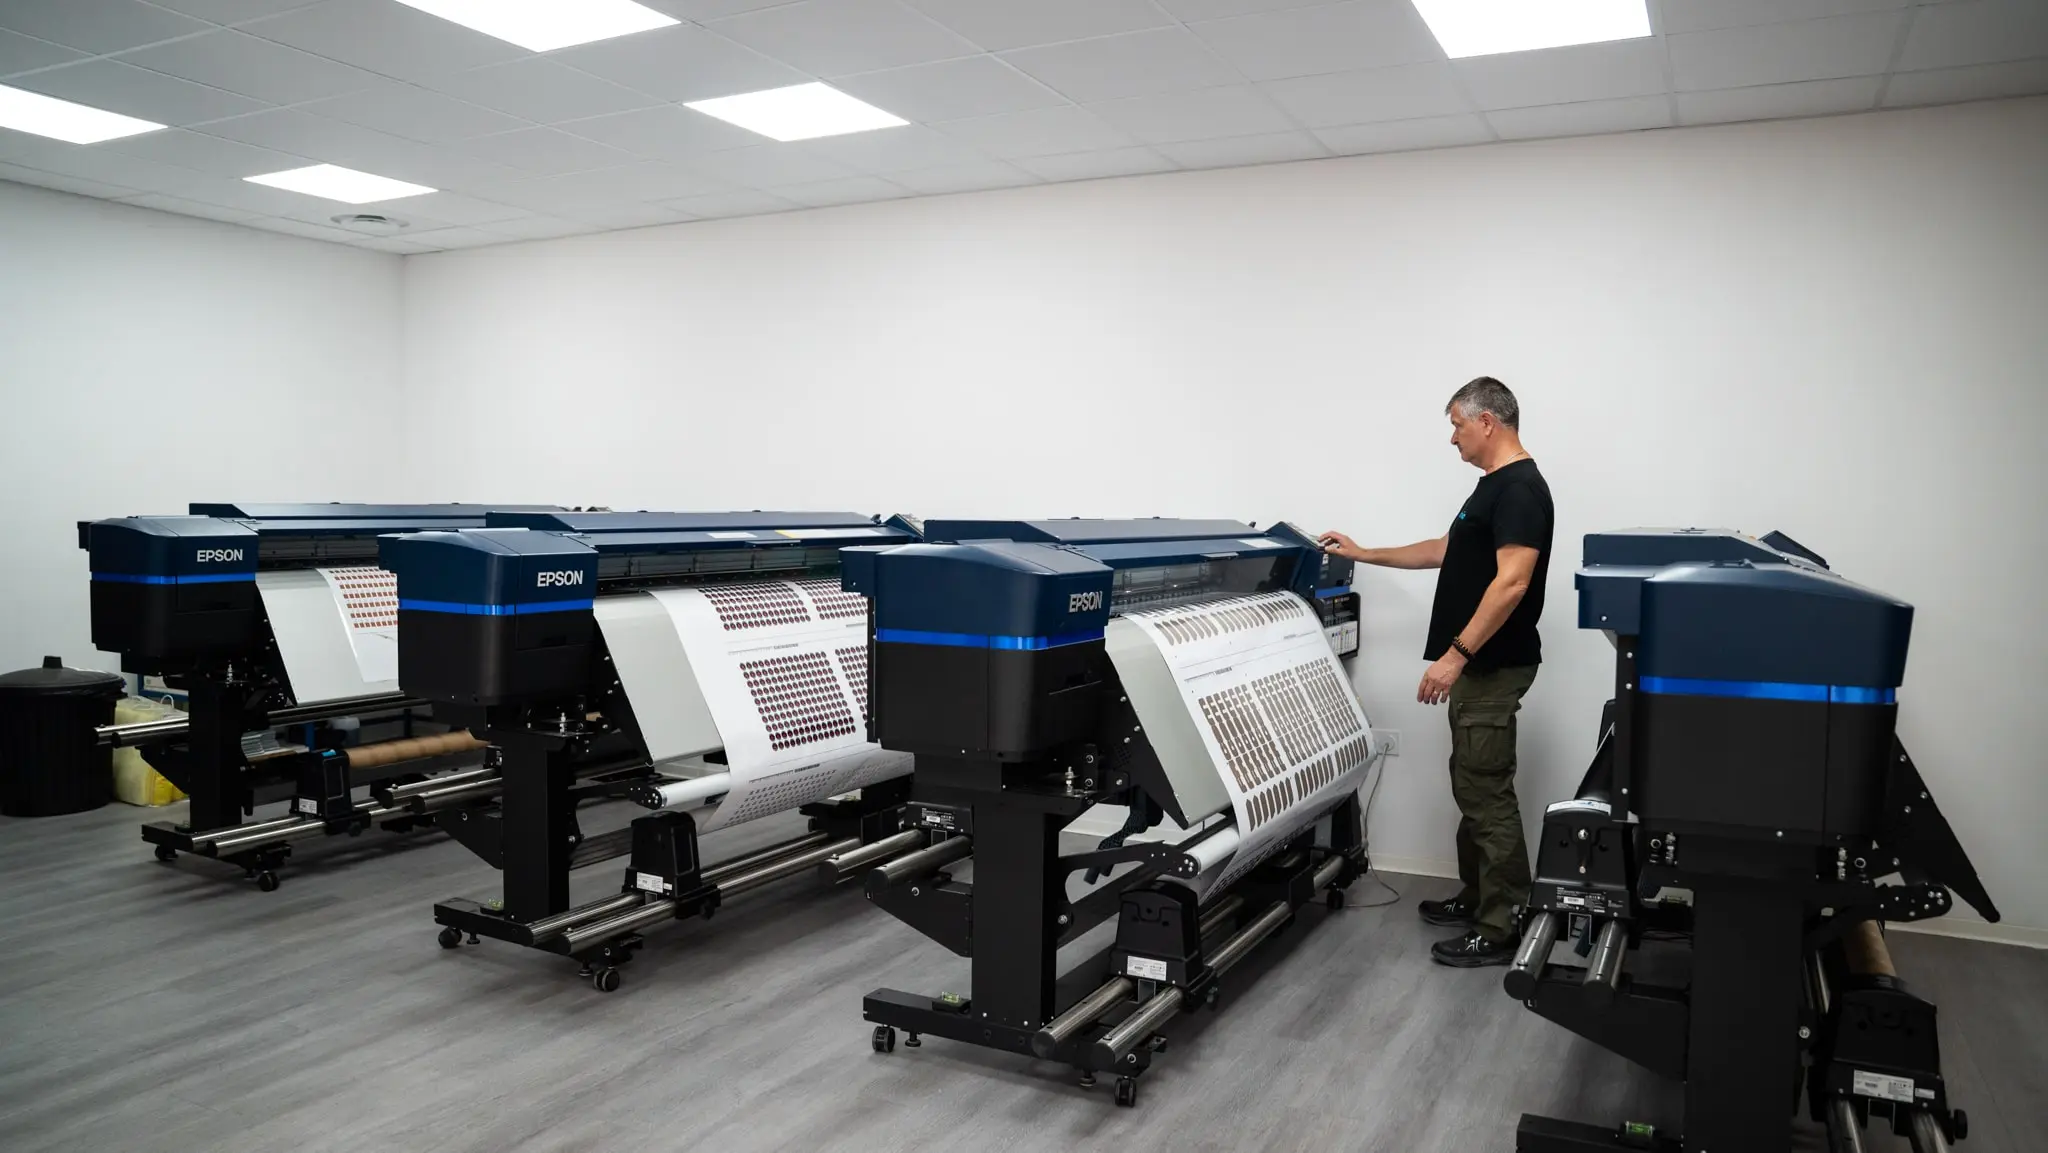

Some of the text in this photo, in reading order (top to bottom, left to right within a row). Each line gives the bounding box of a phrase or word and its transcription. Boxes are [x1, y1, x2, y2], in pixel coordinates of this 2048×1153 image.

[196, 549, 243, 562] EPSON
[537, 570, 583, 587] EPSON
[1069, 591, 1103, 612] EPSON
